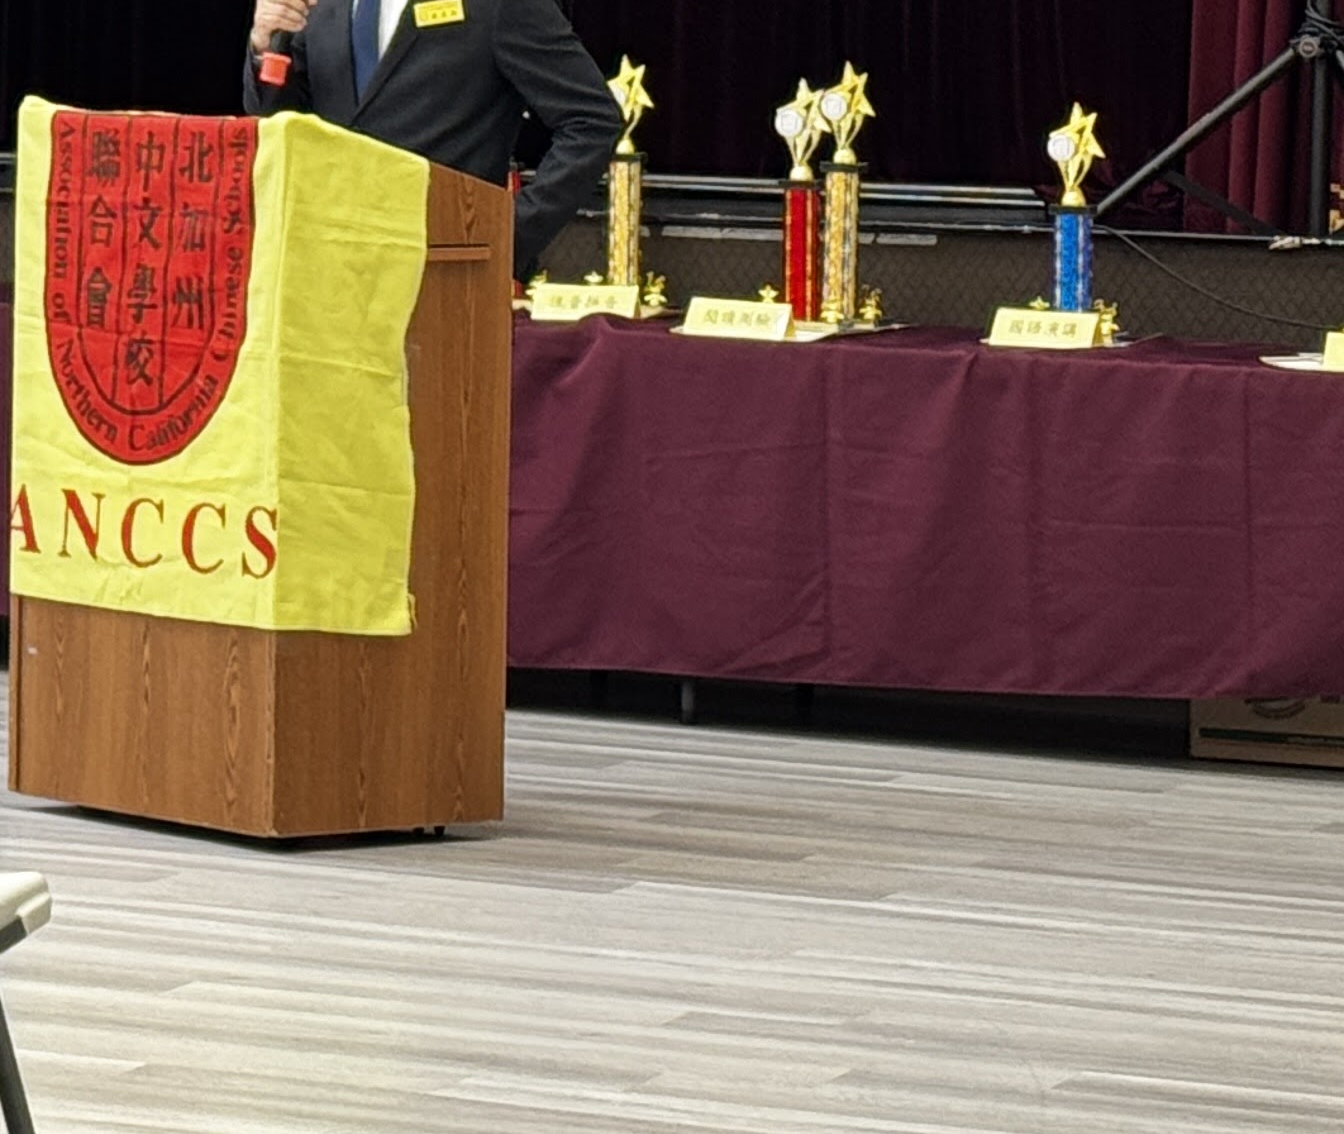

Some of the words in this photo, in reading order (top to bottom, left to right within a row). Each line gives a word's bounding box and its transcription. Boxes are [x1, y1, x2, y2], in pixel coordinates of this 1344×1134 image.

[54, 122, 76, 279] Association
[85, 127, 121, 329] 聯合會
[125, 130, 166, 386] 中文學校
[173, 130, 215, 330] 北加州
[57, 337, 118, 445] Northern
[10, 483, 277, 579] ANCCS
